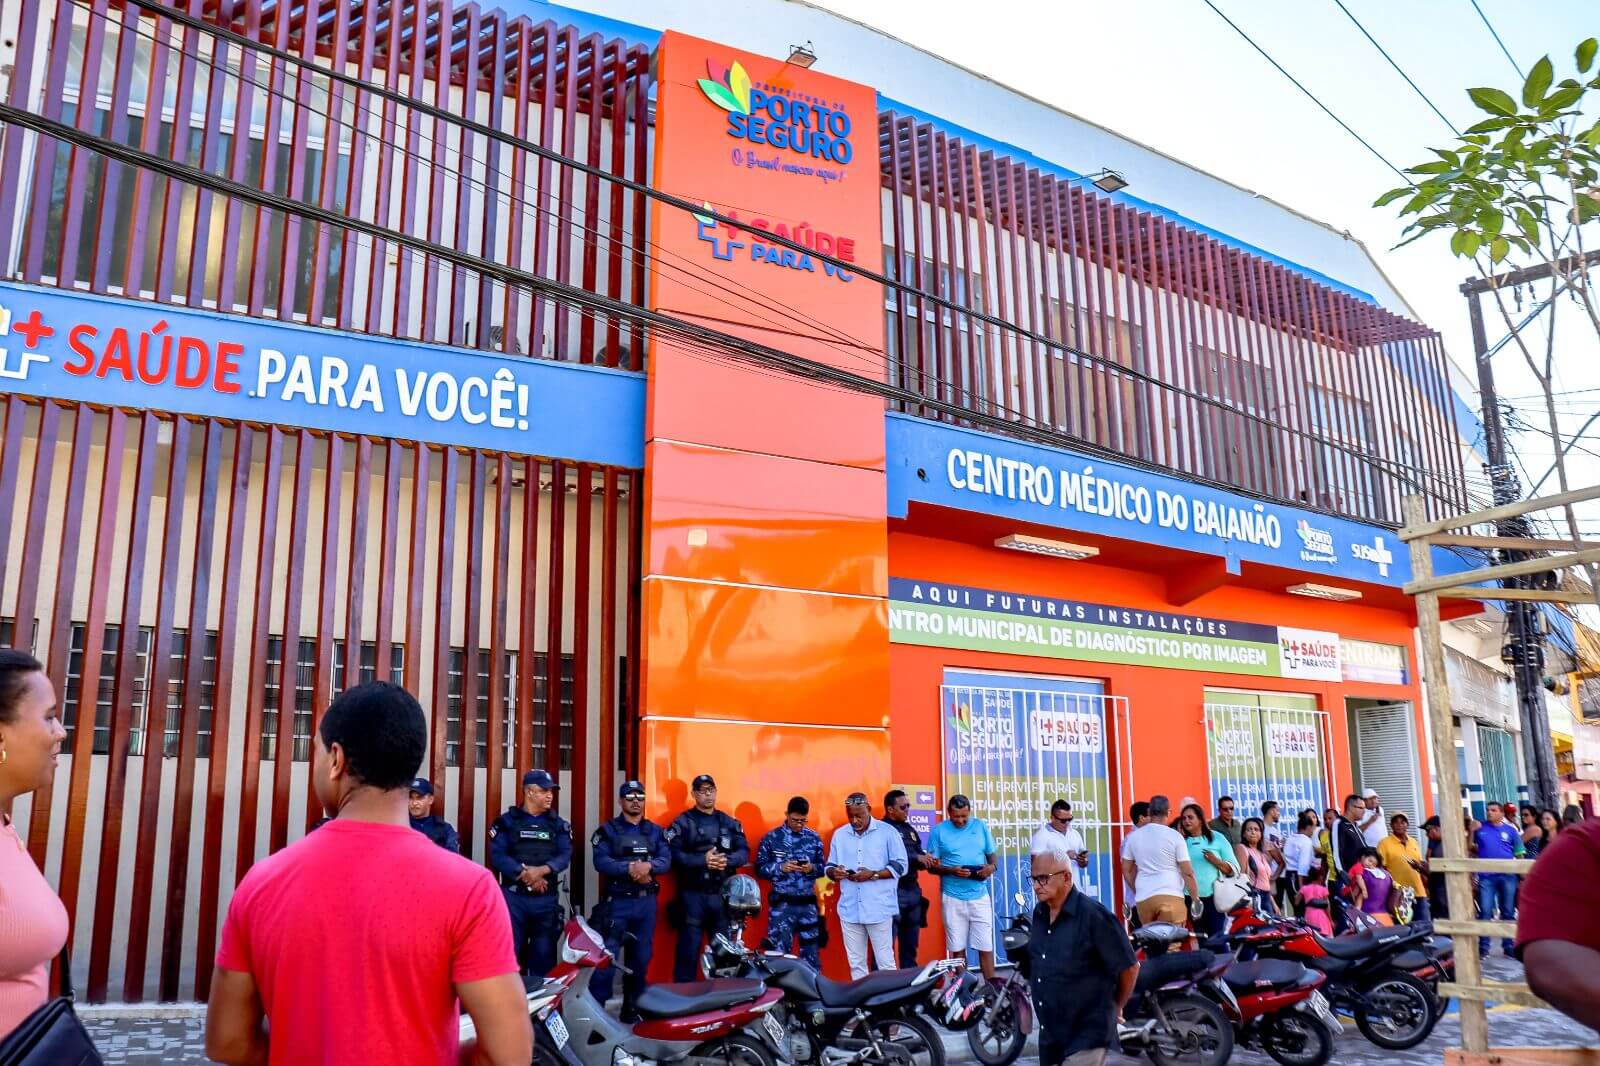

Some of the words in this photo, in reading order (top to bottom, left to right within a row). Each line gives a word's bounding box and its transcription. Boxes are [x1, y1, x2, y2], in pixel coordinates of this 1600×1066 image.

[727, 110, 853, 164] SEGURO
[750, 87, 852, 138] PORTO
[751, 243, 815, 272] PARA
[63, 320, 244, 394] SAÚDE
[256, 348, 385, 413] PARA
[396, 368, 529, 430] VOCÊ!
[947, 448, 1054, 501] CENTRO
[1059, 465, 1152, 525] MÉDICO
[1157, 490, 1190, 531] DO
[1193, 499, 1281, 548] BAIANÃO
[912, 585, 970, 605] AQUI
[986, 593, 1085, 619] FUTURAS
[1098, 608, 1228, 635] INSTALAÇÕES
[889, 608, 943, 635] NTRO
[947, 615, 1048, 646] MUNICIPAL
[1048, 626, 1073, 649] DE
[1075, 630, 1180, 659] DIAGNÓSTICO
[1183, 643, 1214, 661] POR
[1214, 647, 1267, 666] IMAGEM
[1301, 640, 1336, 659] SAÚDE
[1302, 658, 1319, 667] PARA
[911, 815, 928, 823] COM
